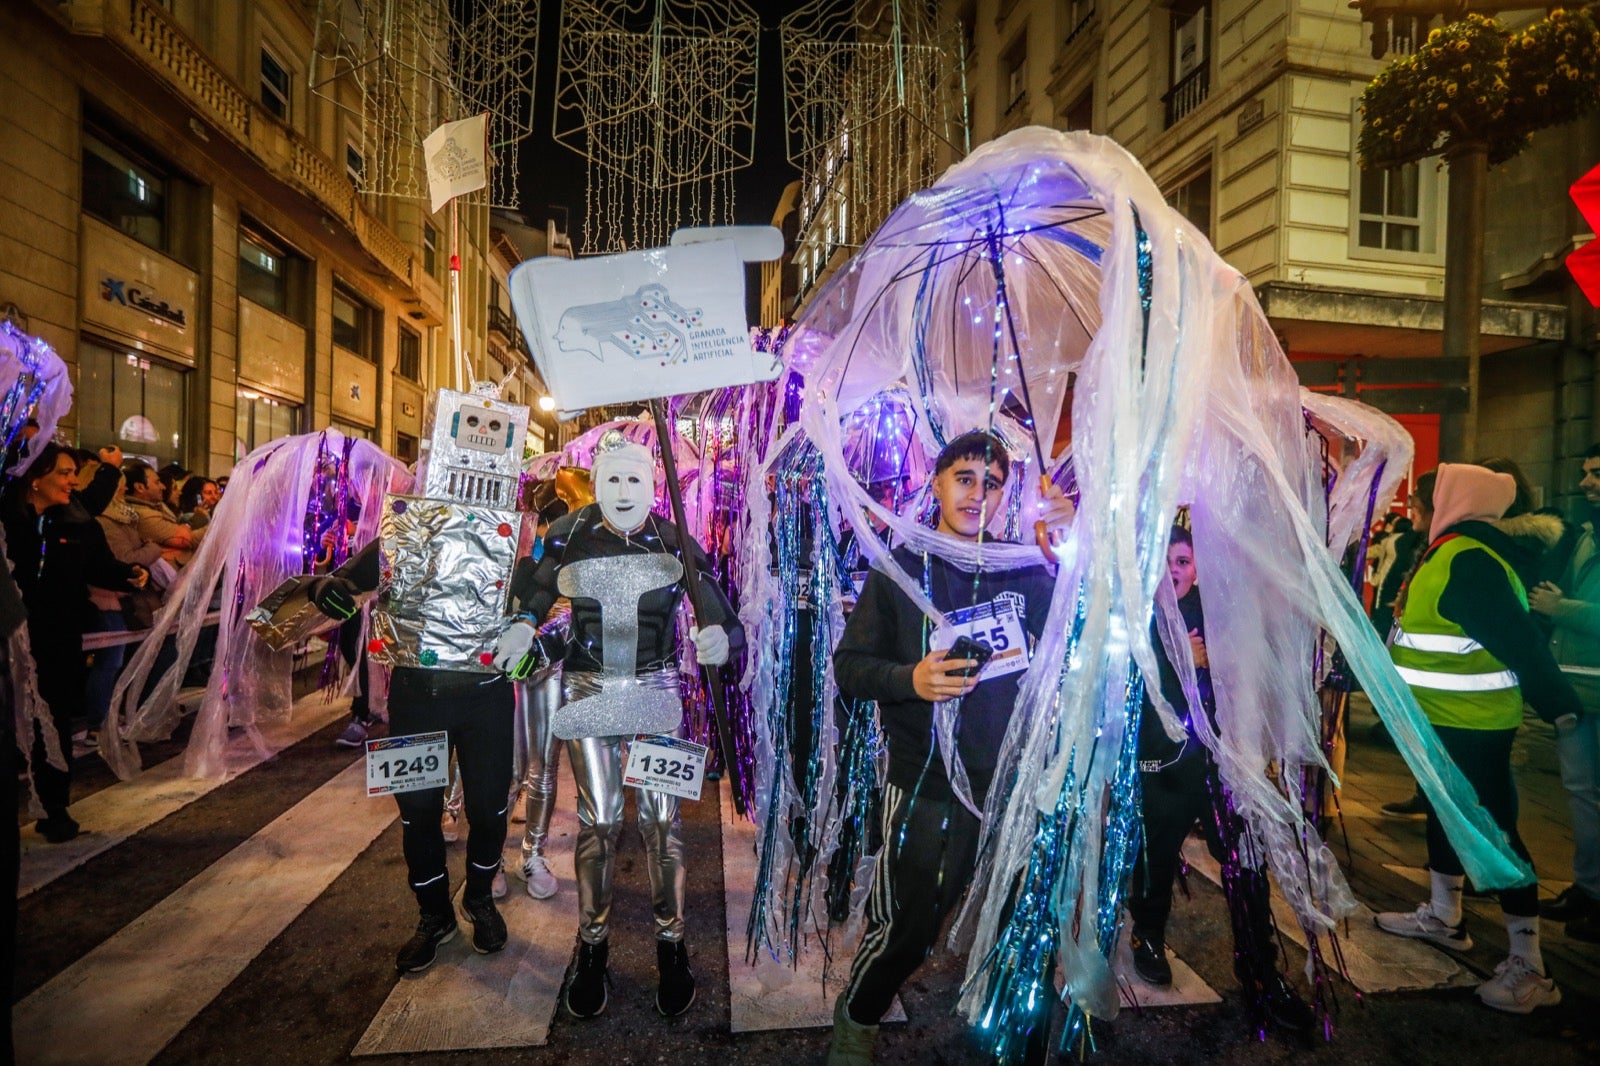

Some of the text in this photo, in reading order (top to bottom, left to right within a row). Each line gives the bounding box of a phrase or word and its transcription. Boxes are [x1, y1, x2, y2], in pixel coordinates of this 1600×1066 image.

[689, 327, 726, 340] GRANADA
[691, 335, 744, 350] INTELIGENCIA
[693, 349, 734, 361] ARTIFICIAL
[379, 755, 439, 778] 1249
[640, 755, 695, 781] 1325
